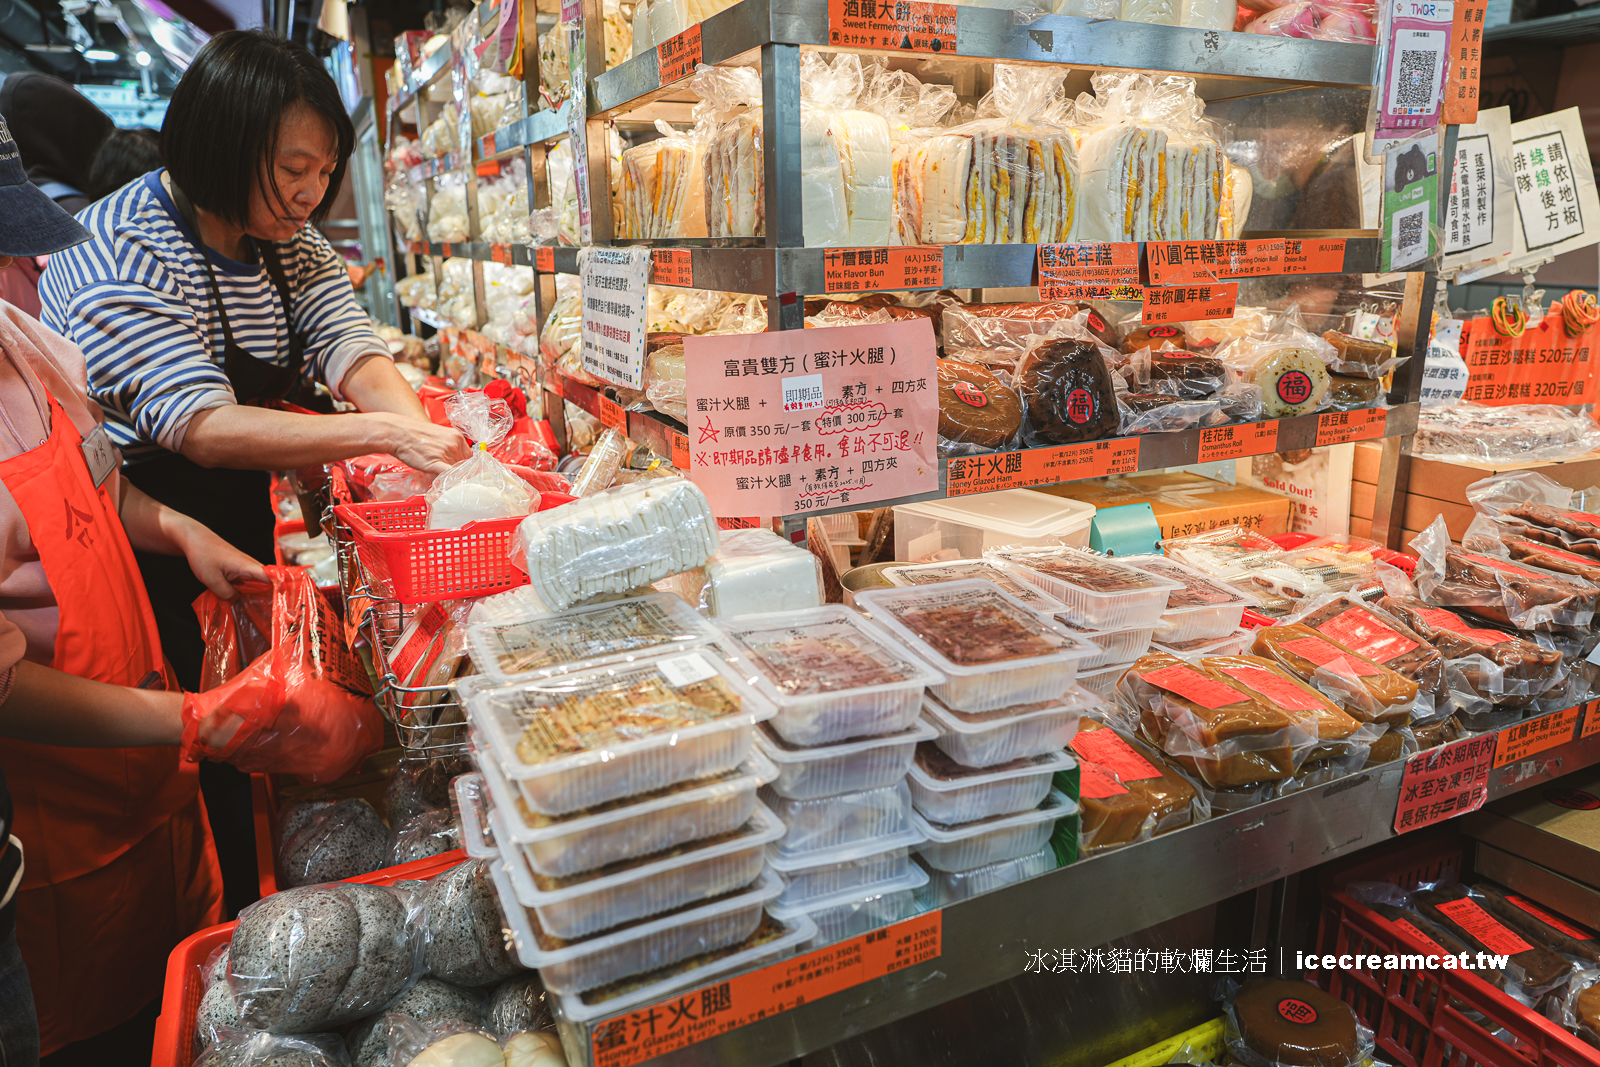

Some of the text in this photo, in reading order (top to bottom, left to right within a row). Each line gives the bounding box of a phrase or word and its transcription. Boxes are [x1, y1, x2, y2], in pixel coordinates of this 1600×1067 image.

[843, 19, 867, 29] Sweet
[928, 25, 942, 35] Bun
[882, 37, 898, 47] まん
[1530, 147, 1560, 232] 綠線後方
[1546, 142, 1579, 226] 請依地板
[825, 248, 943, 268] 千層饅頭 (4入) 150元
[1039, 243, 1113, 269] 傳統年糕
[1150, 243, 1216, 266] 小圓年糕
[1238, 257, 1253, 266] Spring
[827, 268, 885, 279] Mix Flavor Bun
[864, 280, 880, 289] まん
[1148, 287, 1211, 306] 迷你圓年糕
[1538, 347, 1590, 364] 520元/個
[696, 395, 751, 412] 蜜汁火腿
[785, 386, 823, 402] 即期品
[841, 381, 868, 399] 素方
[891, 377, 927, 395] 四方夾
[957, 385, 984, 404] 福
[1282, 376, 1307, 397] 福
[1533, 380, 1585, 398] 320元/個
[1070, 393, 1090, 415] 福
[724, 425, 747, 438] 原價
[750, 425, 771, 437] 350
[821, 415, 842, 429] 特價
[846, 412, 866, 424] 300
[1320, 411, 1349, 428] 綠豆糕
[1202, 426, 1234, 444] 桂花捲
[1319, 429, 1333, 438] Mung
[1334, 427, 1345, 435] Bean
[1201, 439, 1243, 452] Osmanthus Roll
[949, 452, 1022, 481] 蜜汁火腿
[1078, 447, 1094, 457] 350元
[1078, 456, 1094, 464] 250元
[735, 472, 792, 491] 蜜汁火腿
[814, 464, 840, 482] 素方
[862, 456, 898, 474] 四方夾
[949, 475, 1012, 490] Honey Glazed Ham
[1263, 476, 1313, 499] Sold Out!
[793, 499, 813, 511] 350
[1549, 729, 1560, 738] Rice
[1559, 725, 1571, 735] Cake
[593, 982, 733, 1055] 蜜汁火腿
[1285, 1000, 1313, 1021] 福
[598, 1017, 716, 1065] Honey Glazed Ham
